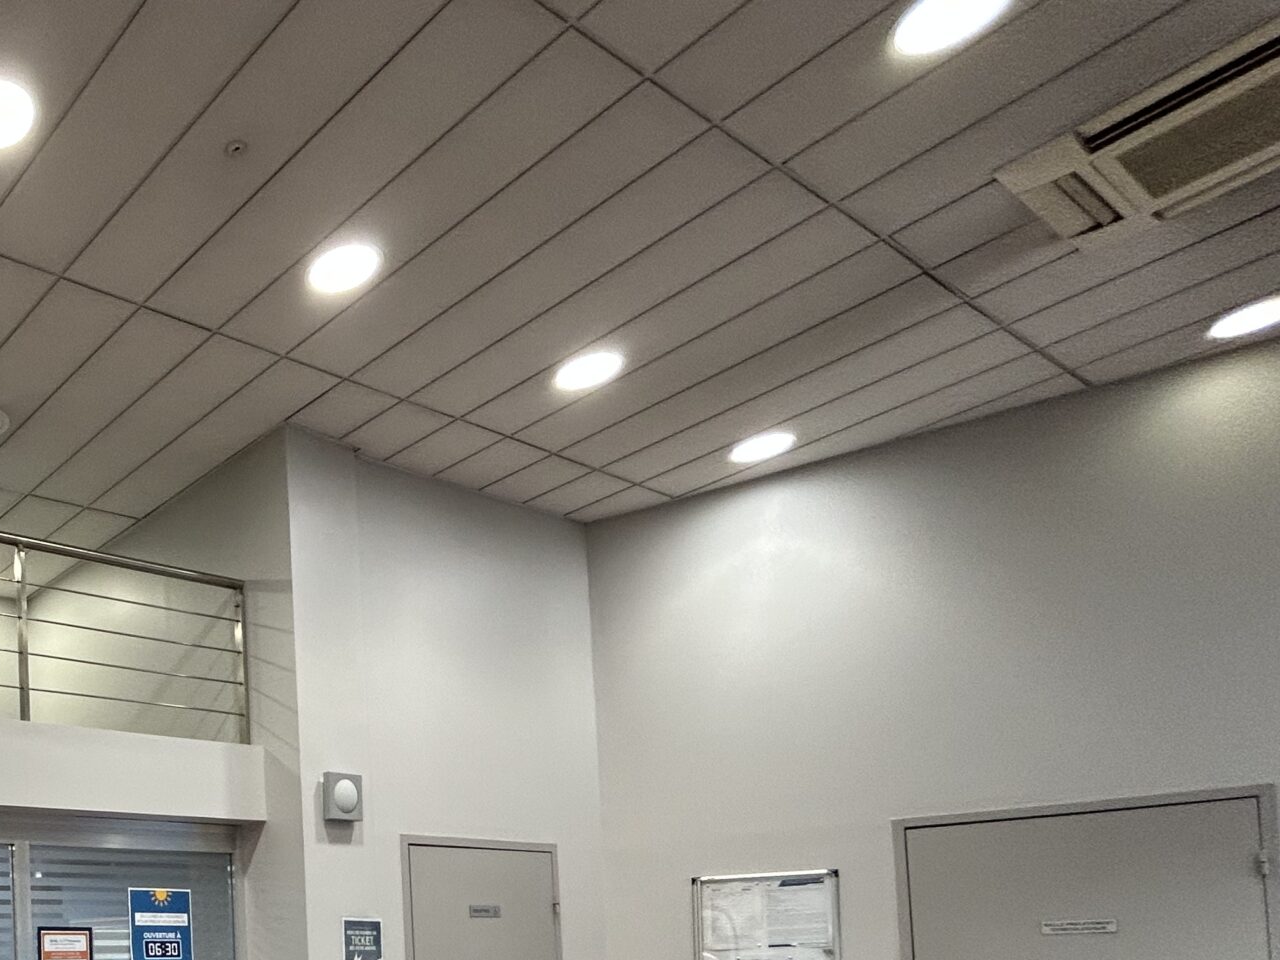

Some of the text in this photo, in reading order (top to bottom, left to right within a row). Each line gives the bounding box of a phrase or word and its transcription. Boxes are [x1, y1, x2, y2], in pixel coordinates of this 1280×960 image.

[176, 930, 182, 939] À
[351, 935, 374, 946] TICKET
[148, 943, 178, 956] 06:30
